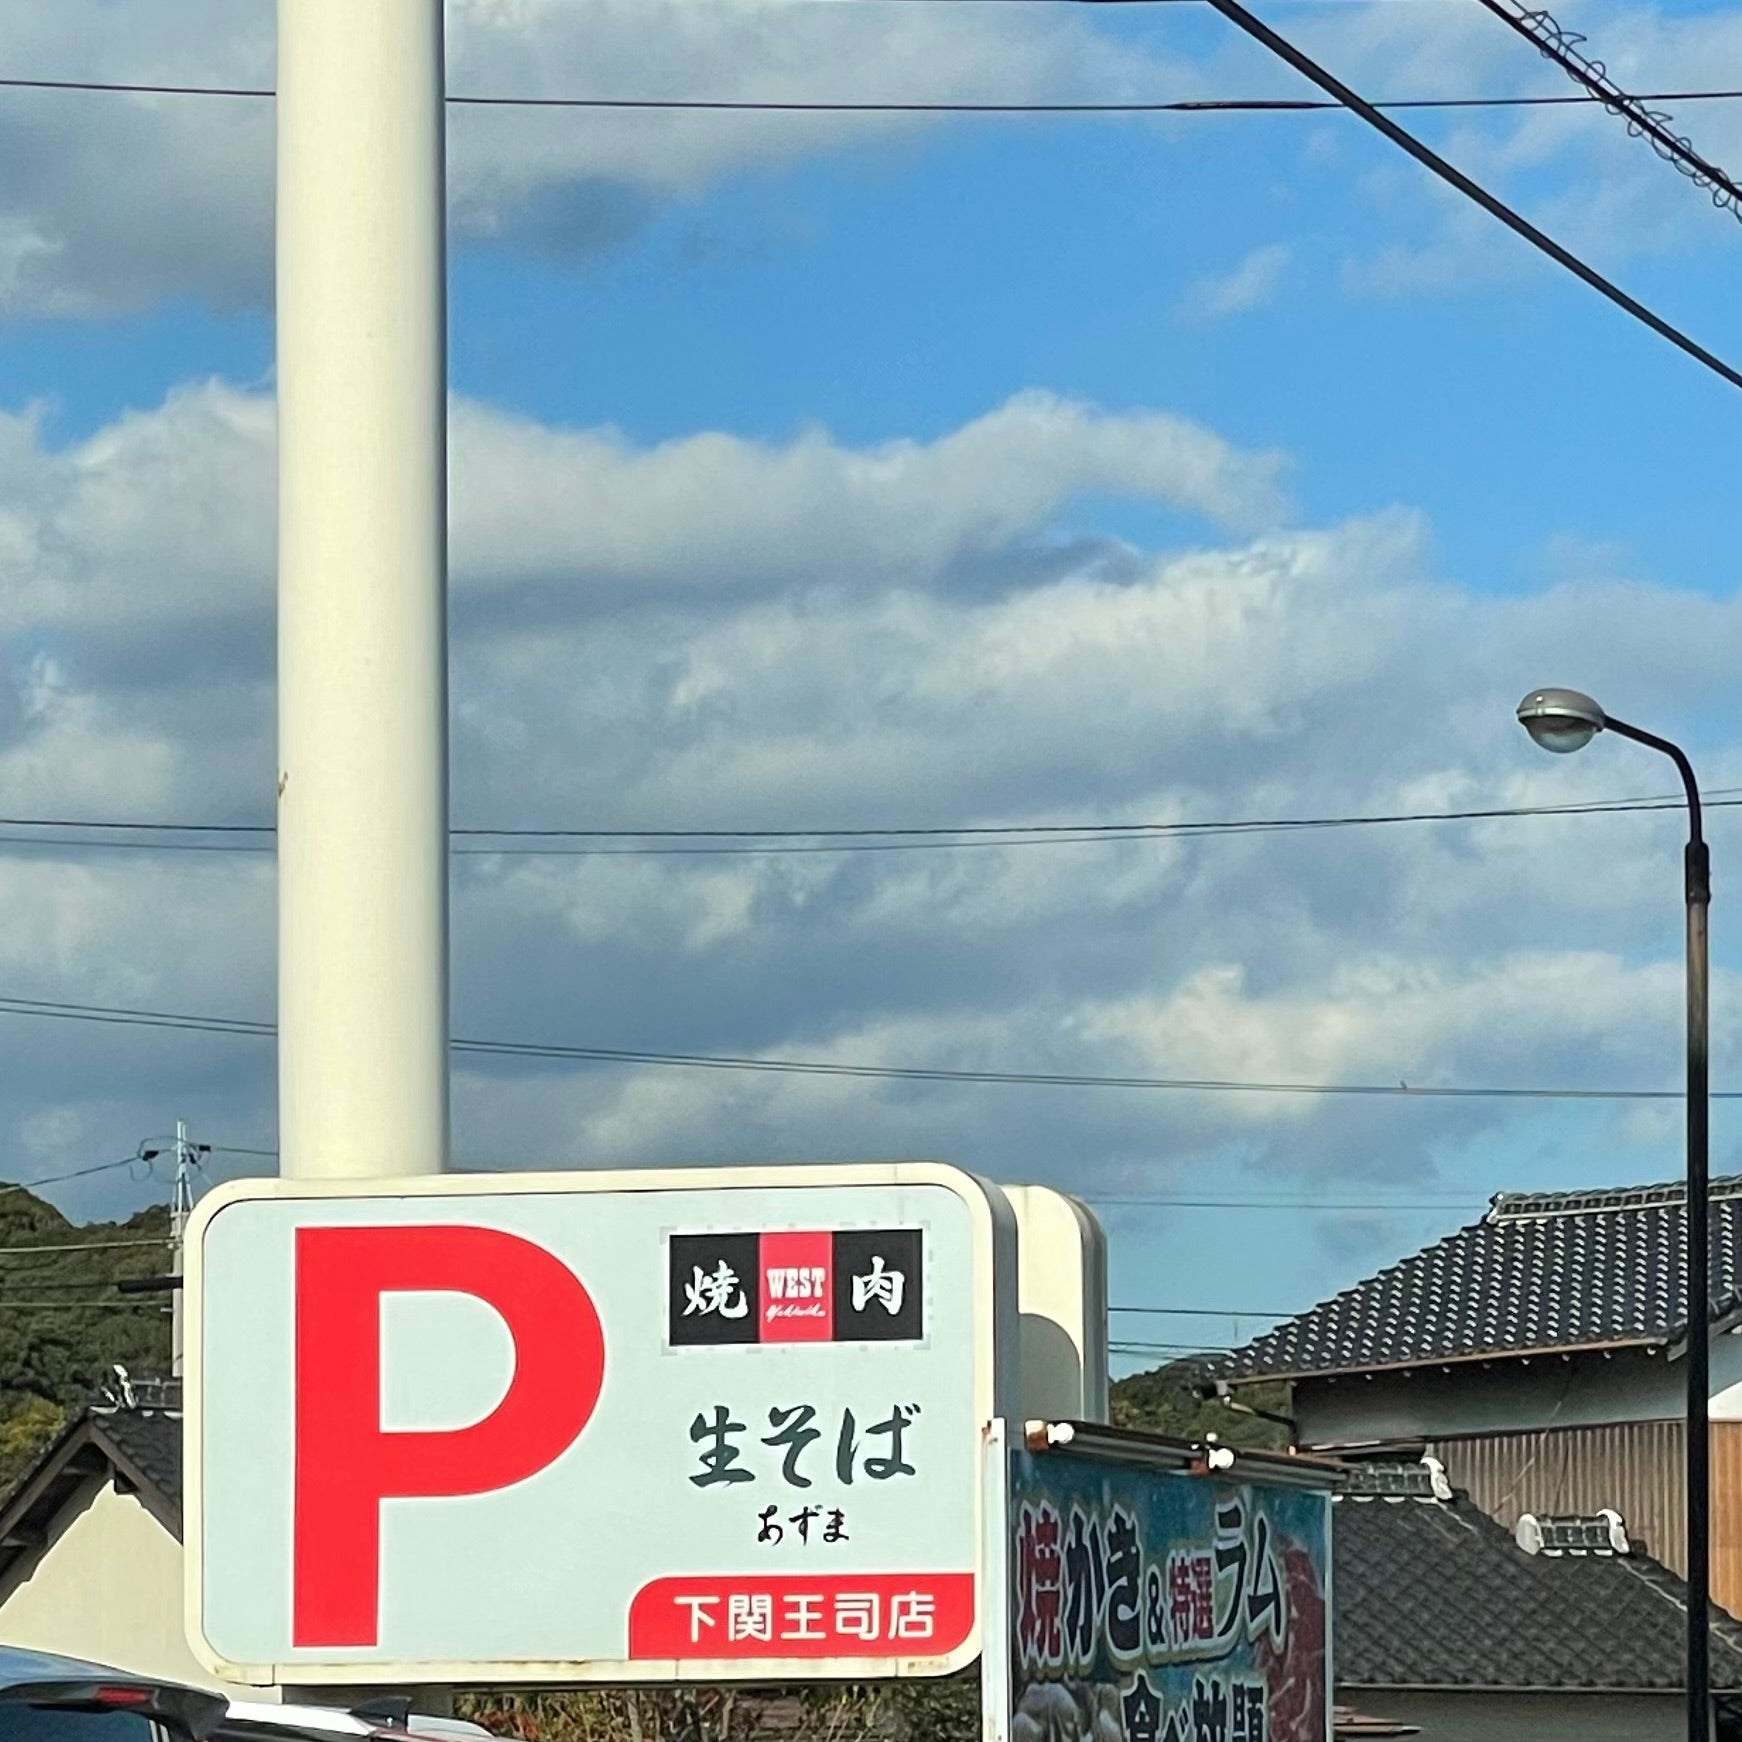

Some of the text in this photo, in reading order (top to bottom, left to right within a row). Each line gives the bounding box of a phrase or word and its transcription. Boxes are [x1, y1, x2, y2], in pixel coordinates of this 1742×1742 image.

[680, 1255, 905, 1319] 焼 肉
[765, 1266, 826, 1299] WEST
[293, 1225, 605, 1648] P
[688, 1402, 922, 1489] 生そば
[757, 1503, 850, 1547] あずま
[673, 1591, 936, 1643] 下関王司店
